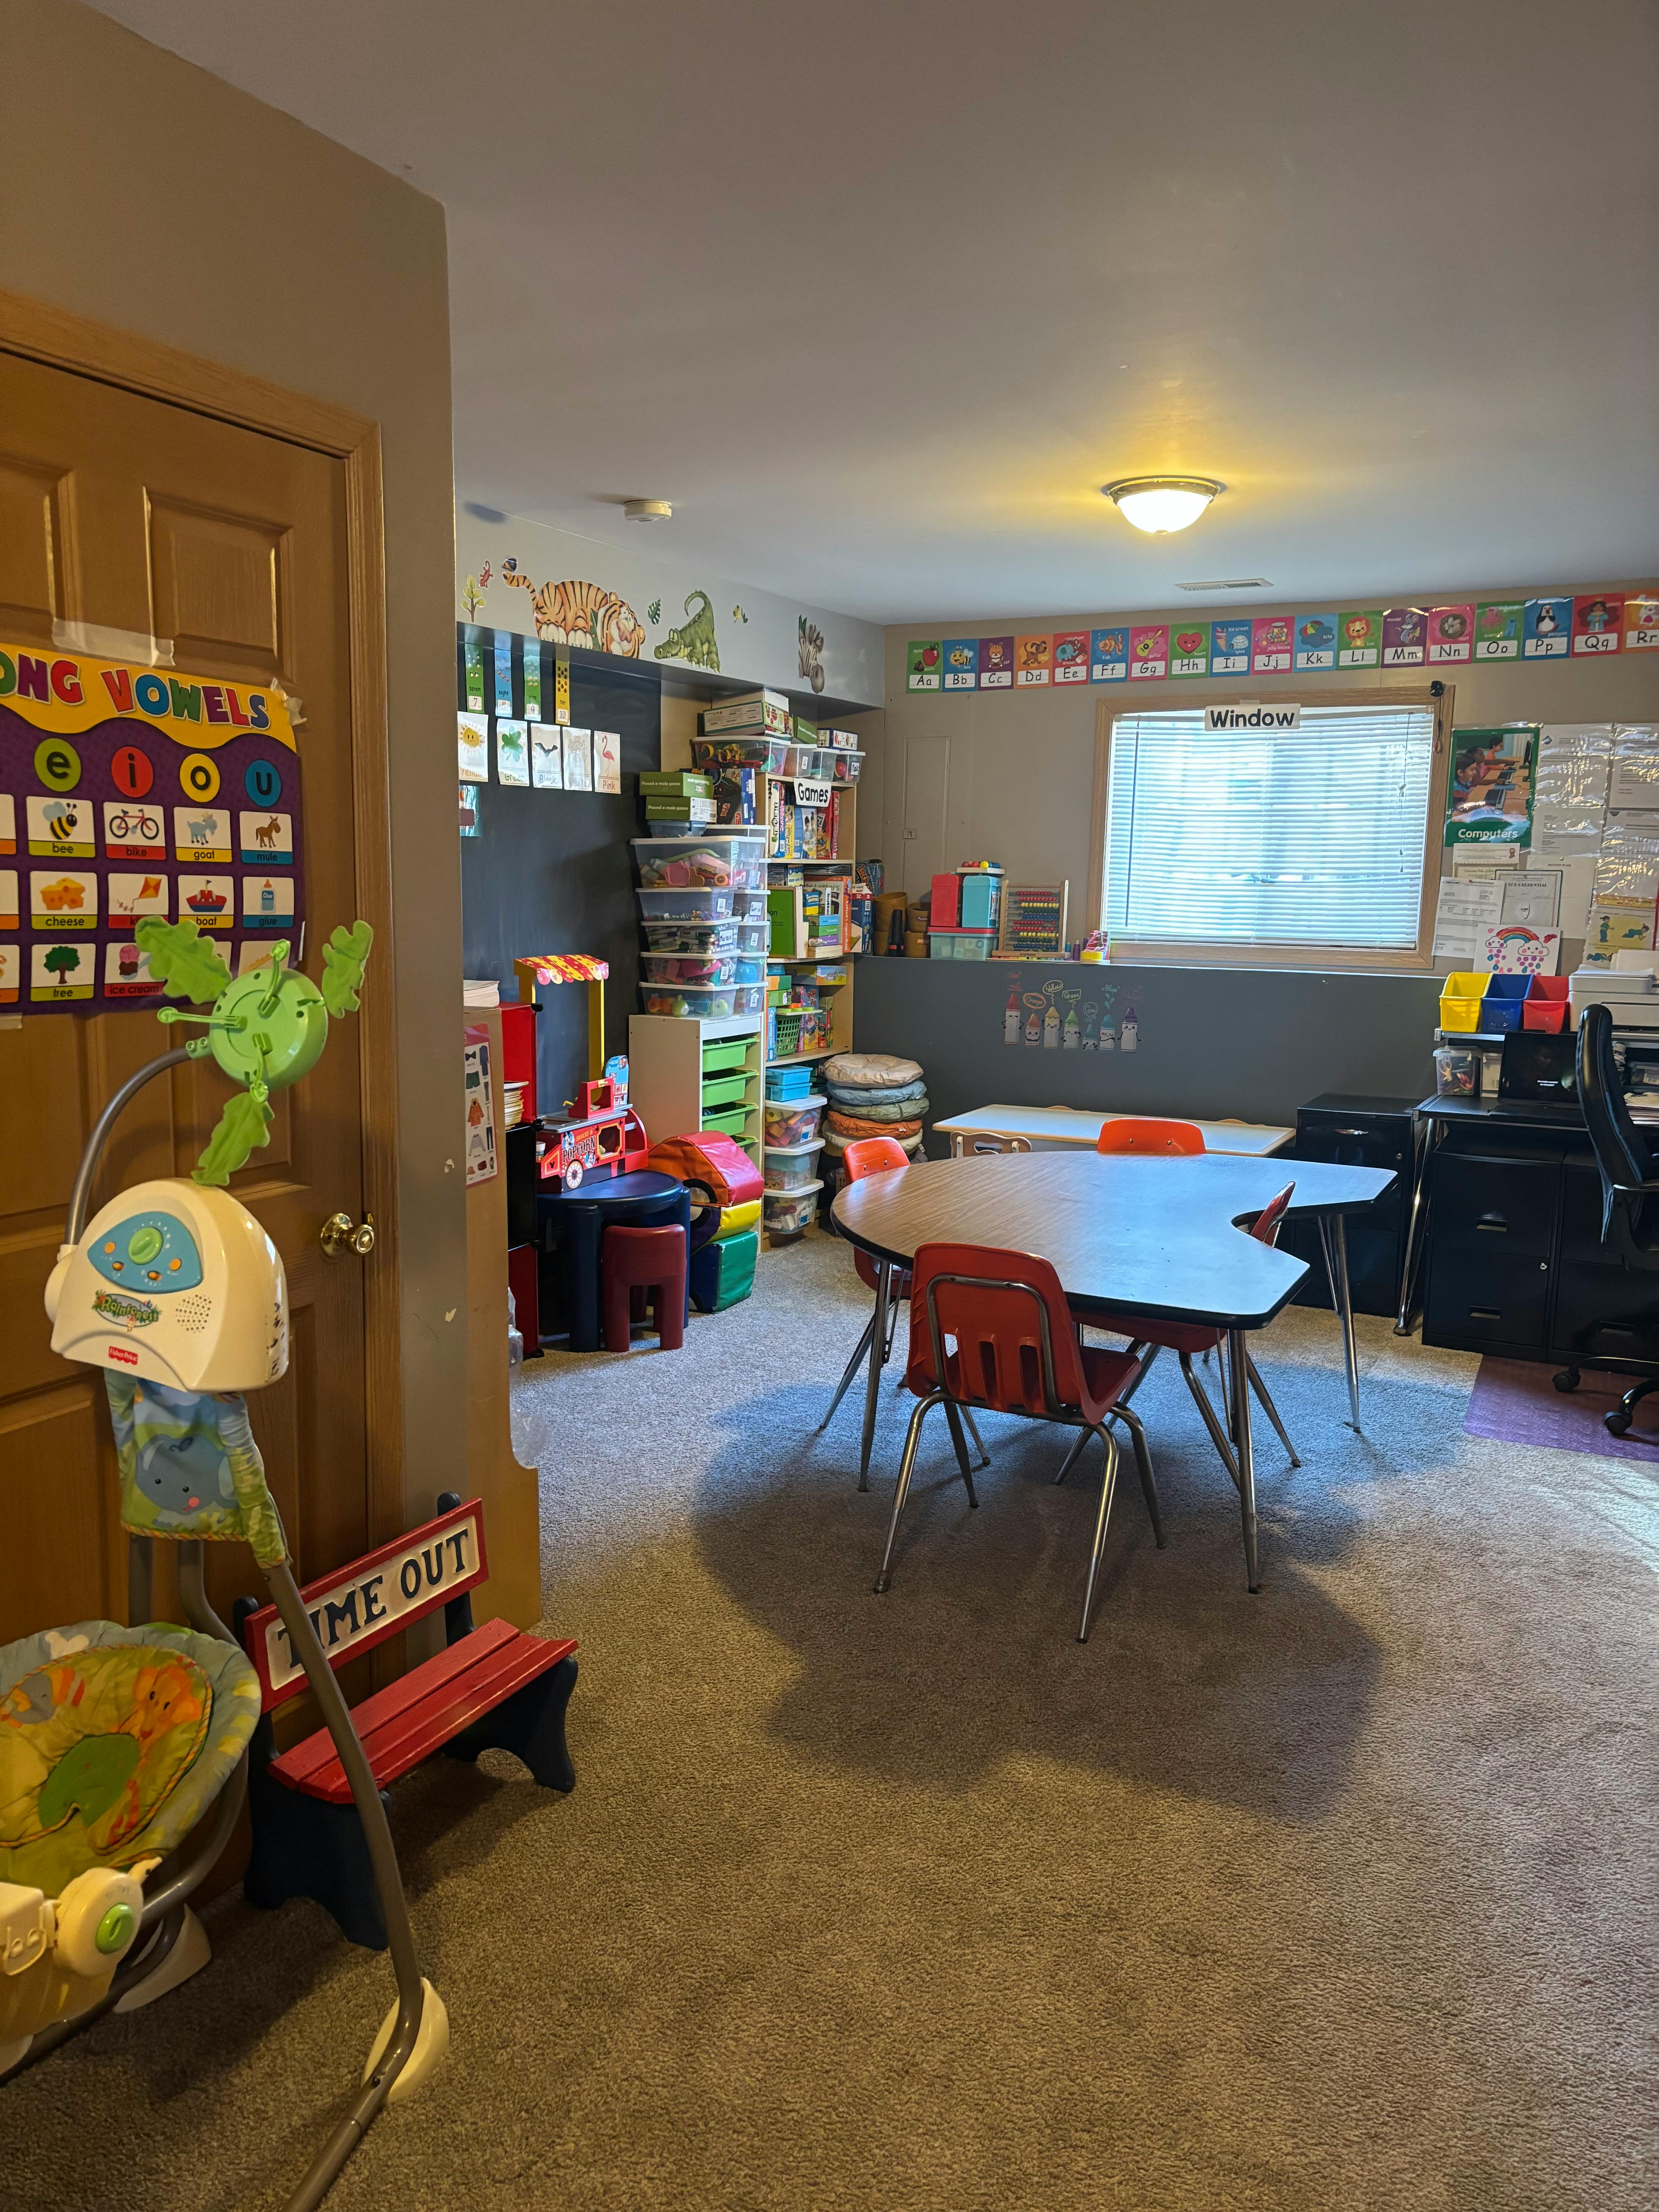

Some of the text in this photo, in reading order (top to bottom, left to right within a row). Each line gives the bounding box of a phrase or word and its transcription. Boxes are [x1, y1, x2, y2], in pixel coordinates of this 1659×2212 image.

[1585, 635, 1609, 651] Qq
[1637, 631, 1657, 644] Rr
[1439, 645, 1460, 657] Nn
[1487, 641, 1508, 654] Oo
[1535, 639, 1553, 654] Pp
[1306, 652, 1323, 665] Kk
[1392, 648, 1417, 660] Mm
[1180, 658, 1198, 671] Hh
[1223, 658, 1235, 669] Ii
[1263, 655, 1278, 669] Jj
[1063, 667, 1078, 679] Ee
[1101, 665, 1116, 676] Ff
[1140, 662, 1156, 676] Gg
[916, 675, 932, 686] Aa
[953, 674, 967, 685] Bb
[988, 673, 1003, 683] Cc
[1025, 671, 1042, 682] Dd
[100, 669, 270, 729] VOWELS
[473, 698, 478, 707] 7
[501, 702, 506, 711] 8
[531, 706, 535, 714] 9
[560, 710, 566, 719] 10
[1210, 708, 1295, 728] Window
[46, 752, 272, 795] e i o u
[539, 774, 557, 785] Black
[603, 780, 616, 790] Pink
[798, 783, 828, 803] Games
[1458, 829, 1518, 839] Computers
[52, 843, 74, 854] bee
[125, 846, 147, 857] bike
[194, 850, 215, 860] goat
[257, 852, 277, 862] mule
[45, 916, 84, 926] cheese
[196, 916, 217, 926] boat
[259, 916, 277, 927] glue
[53, 988, 74, 998] tree
[110, 985, 159, 994] ice cream
[1046, 983, 1062, 993] Yellow
[1105, 984, 1118, 993] Blue
[576, 1130, 589, 1141] SNACKS
[563, 1136, 596, 1162] POPCORN
[101, 1296, 159, 1322] Rainforest
[278, 1528, 468, 1668] TIME OUT
